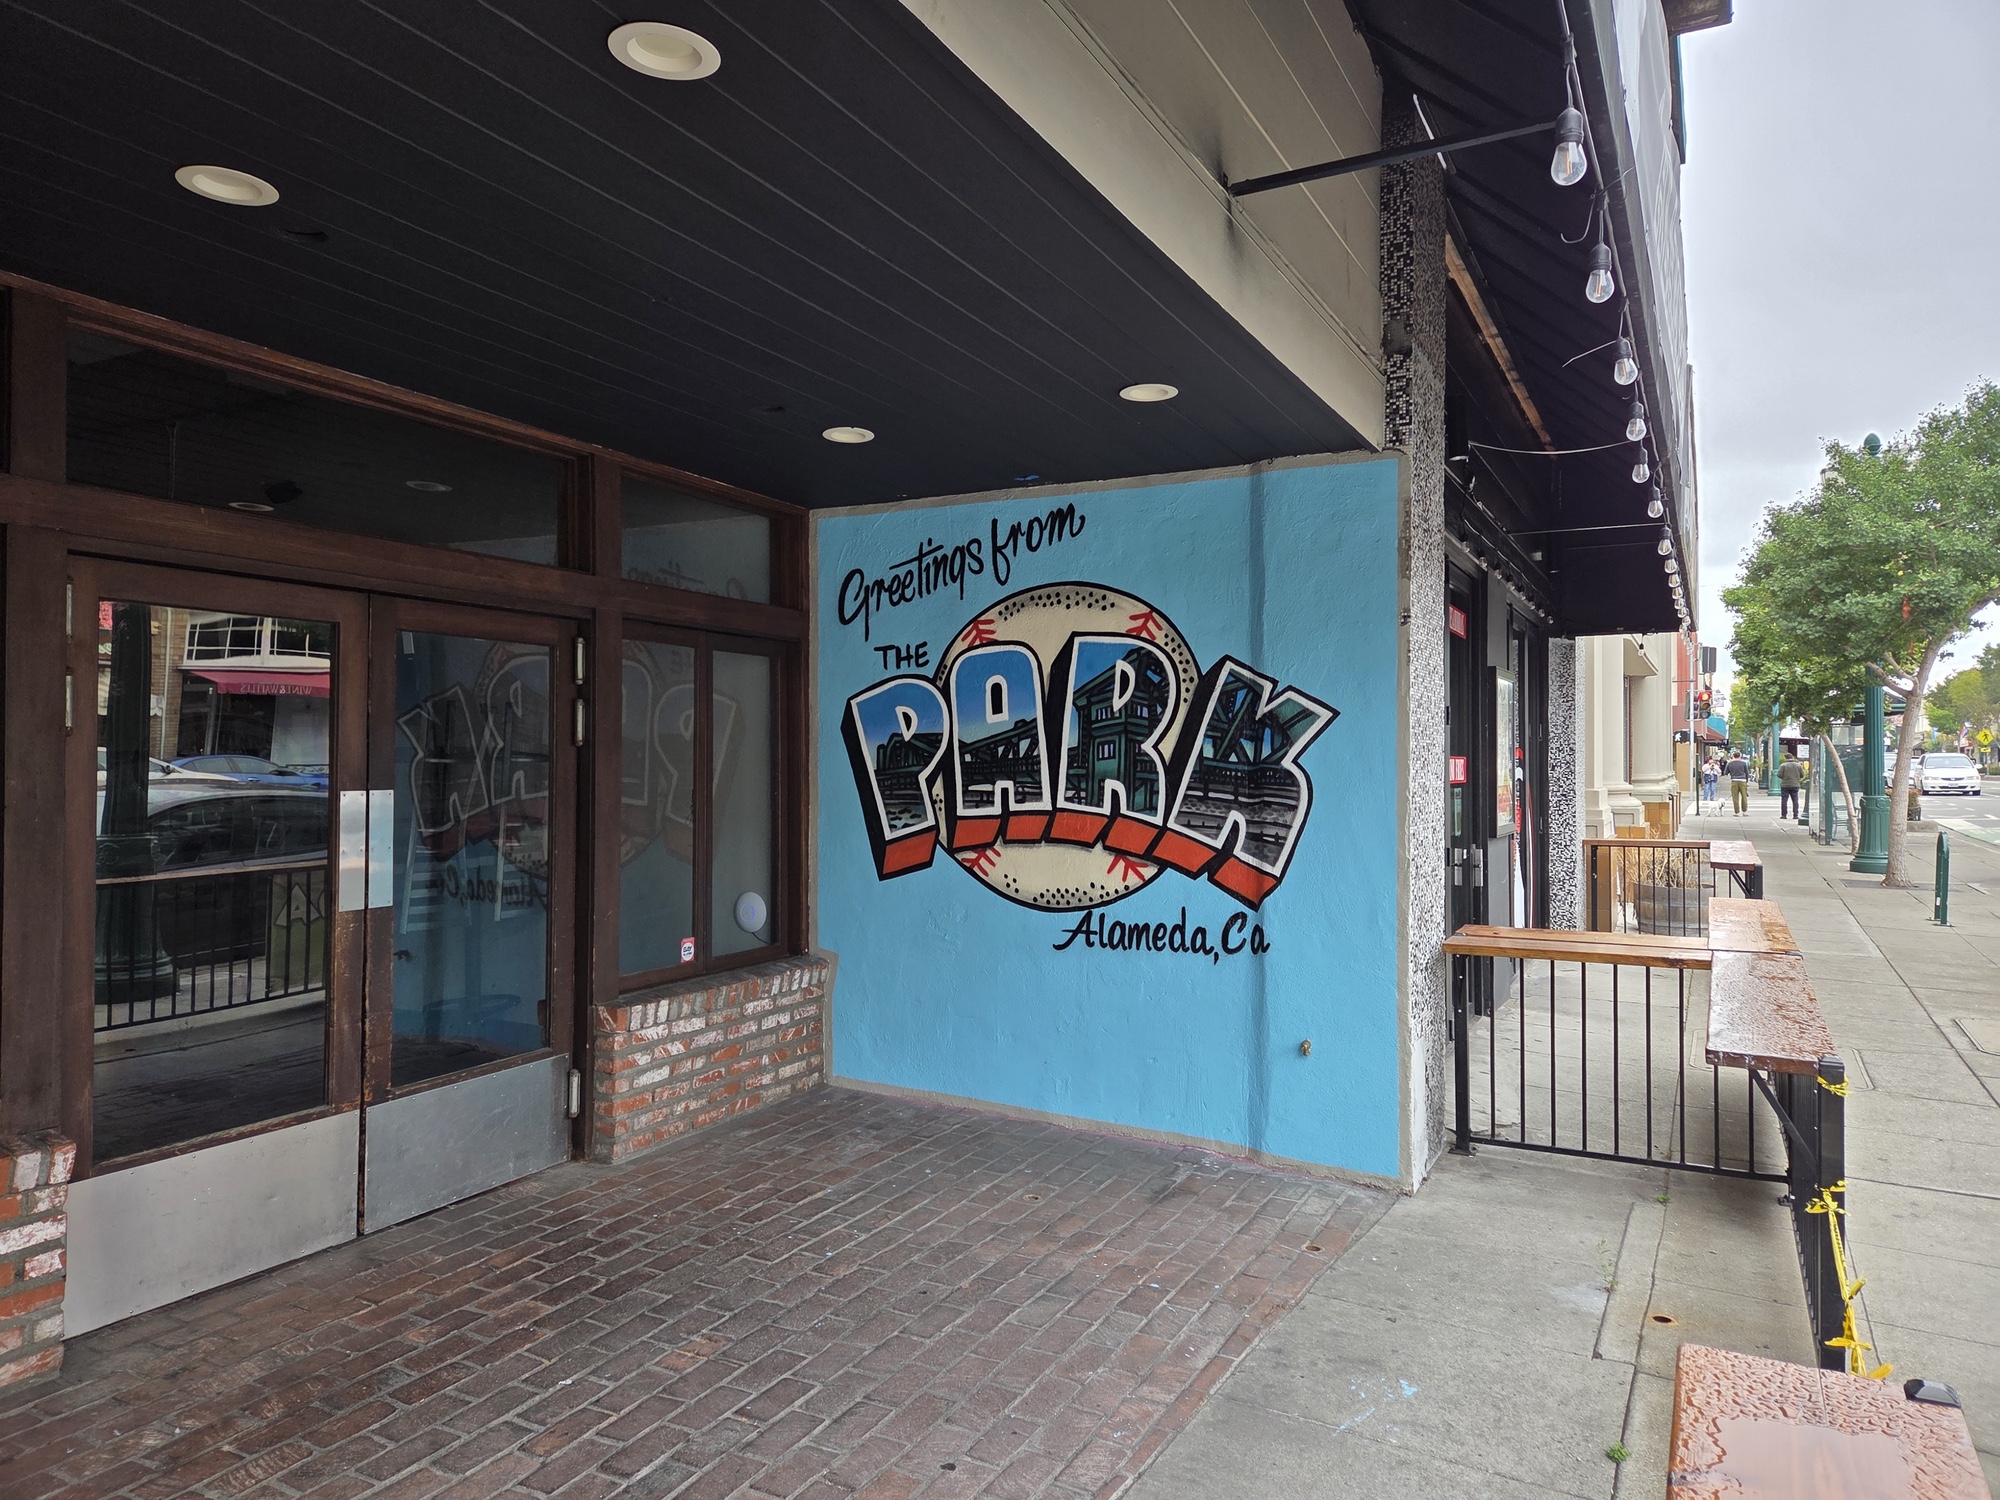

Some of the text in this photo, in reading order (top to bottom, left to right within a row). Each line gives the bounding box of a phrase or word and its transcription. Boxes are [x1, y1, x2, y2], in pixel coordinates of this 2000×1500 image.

[838, 538, 984, 642] Greetings
[991, 503, 1086, 586] from
[874, 641, 930, 671] THE
[841, 632, 1341, 910] PARK
[1053, 906, 1271, 965] Alameda, Ca
